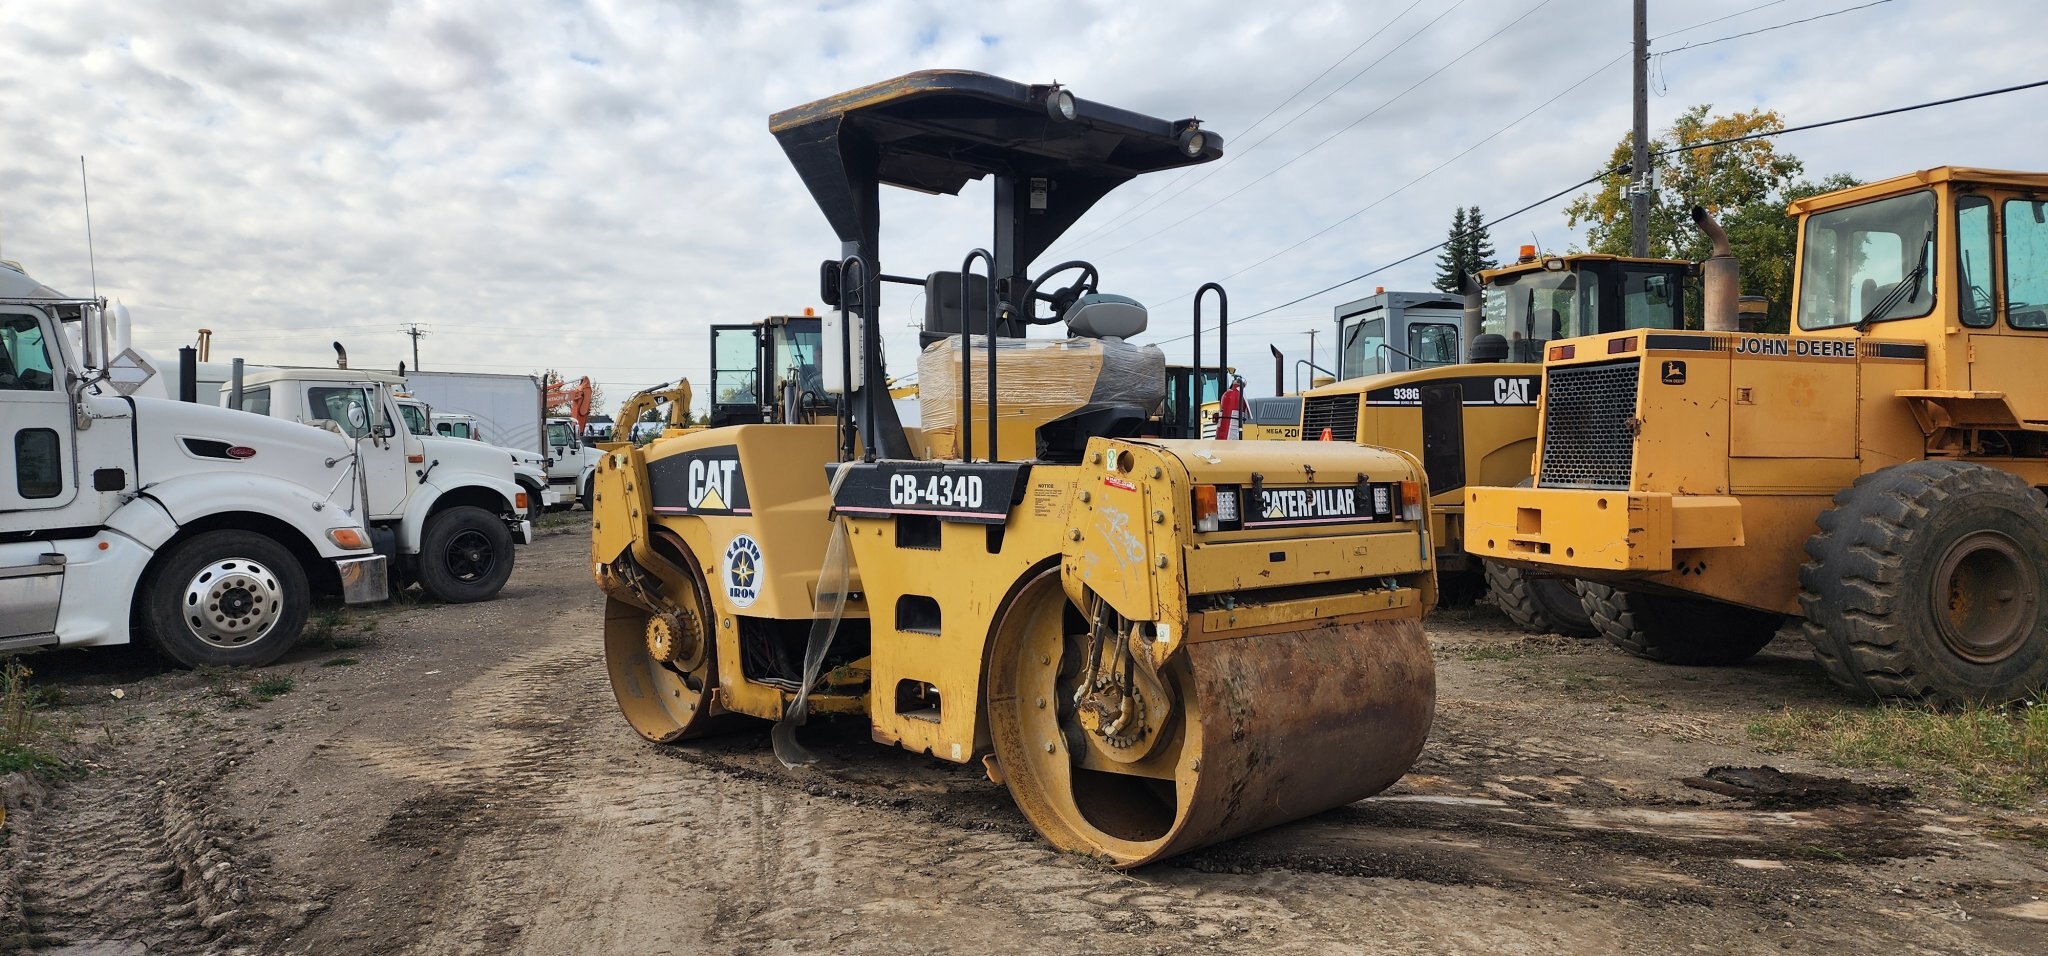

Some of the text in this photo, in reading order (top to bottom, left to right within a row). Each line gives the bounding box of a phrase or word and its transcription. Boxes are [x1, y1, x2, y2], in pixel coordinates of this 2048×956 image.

[1736, 337, 1857, 358] JOHN DEERE
[1393, 387, 1420, 400] 938G
[1493, 377, 1531, 404] CAT
[688, 459, 736, 510] CAT
[889, 473, 983, 508] CB-434D
[1261, 488, 1356, 518] CATERPILLAR
[726, 537, 761, 561] EARTH
[729, 587, 755, 599] IRON
